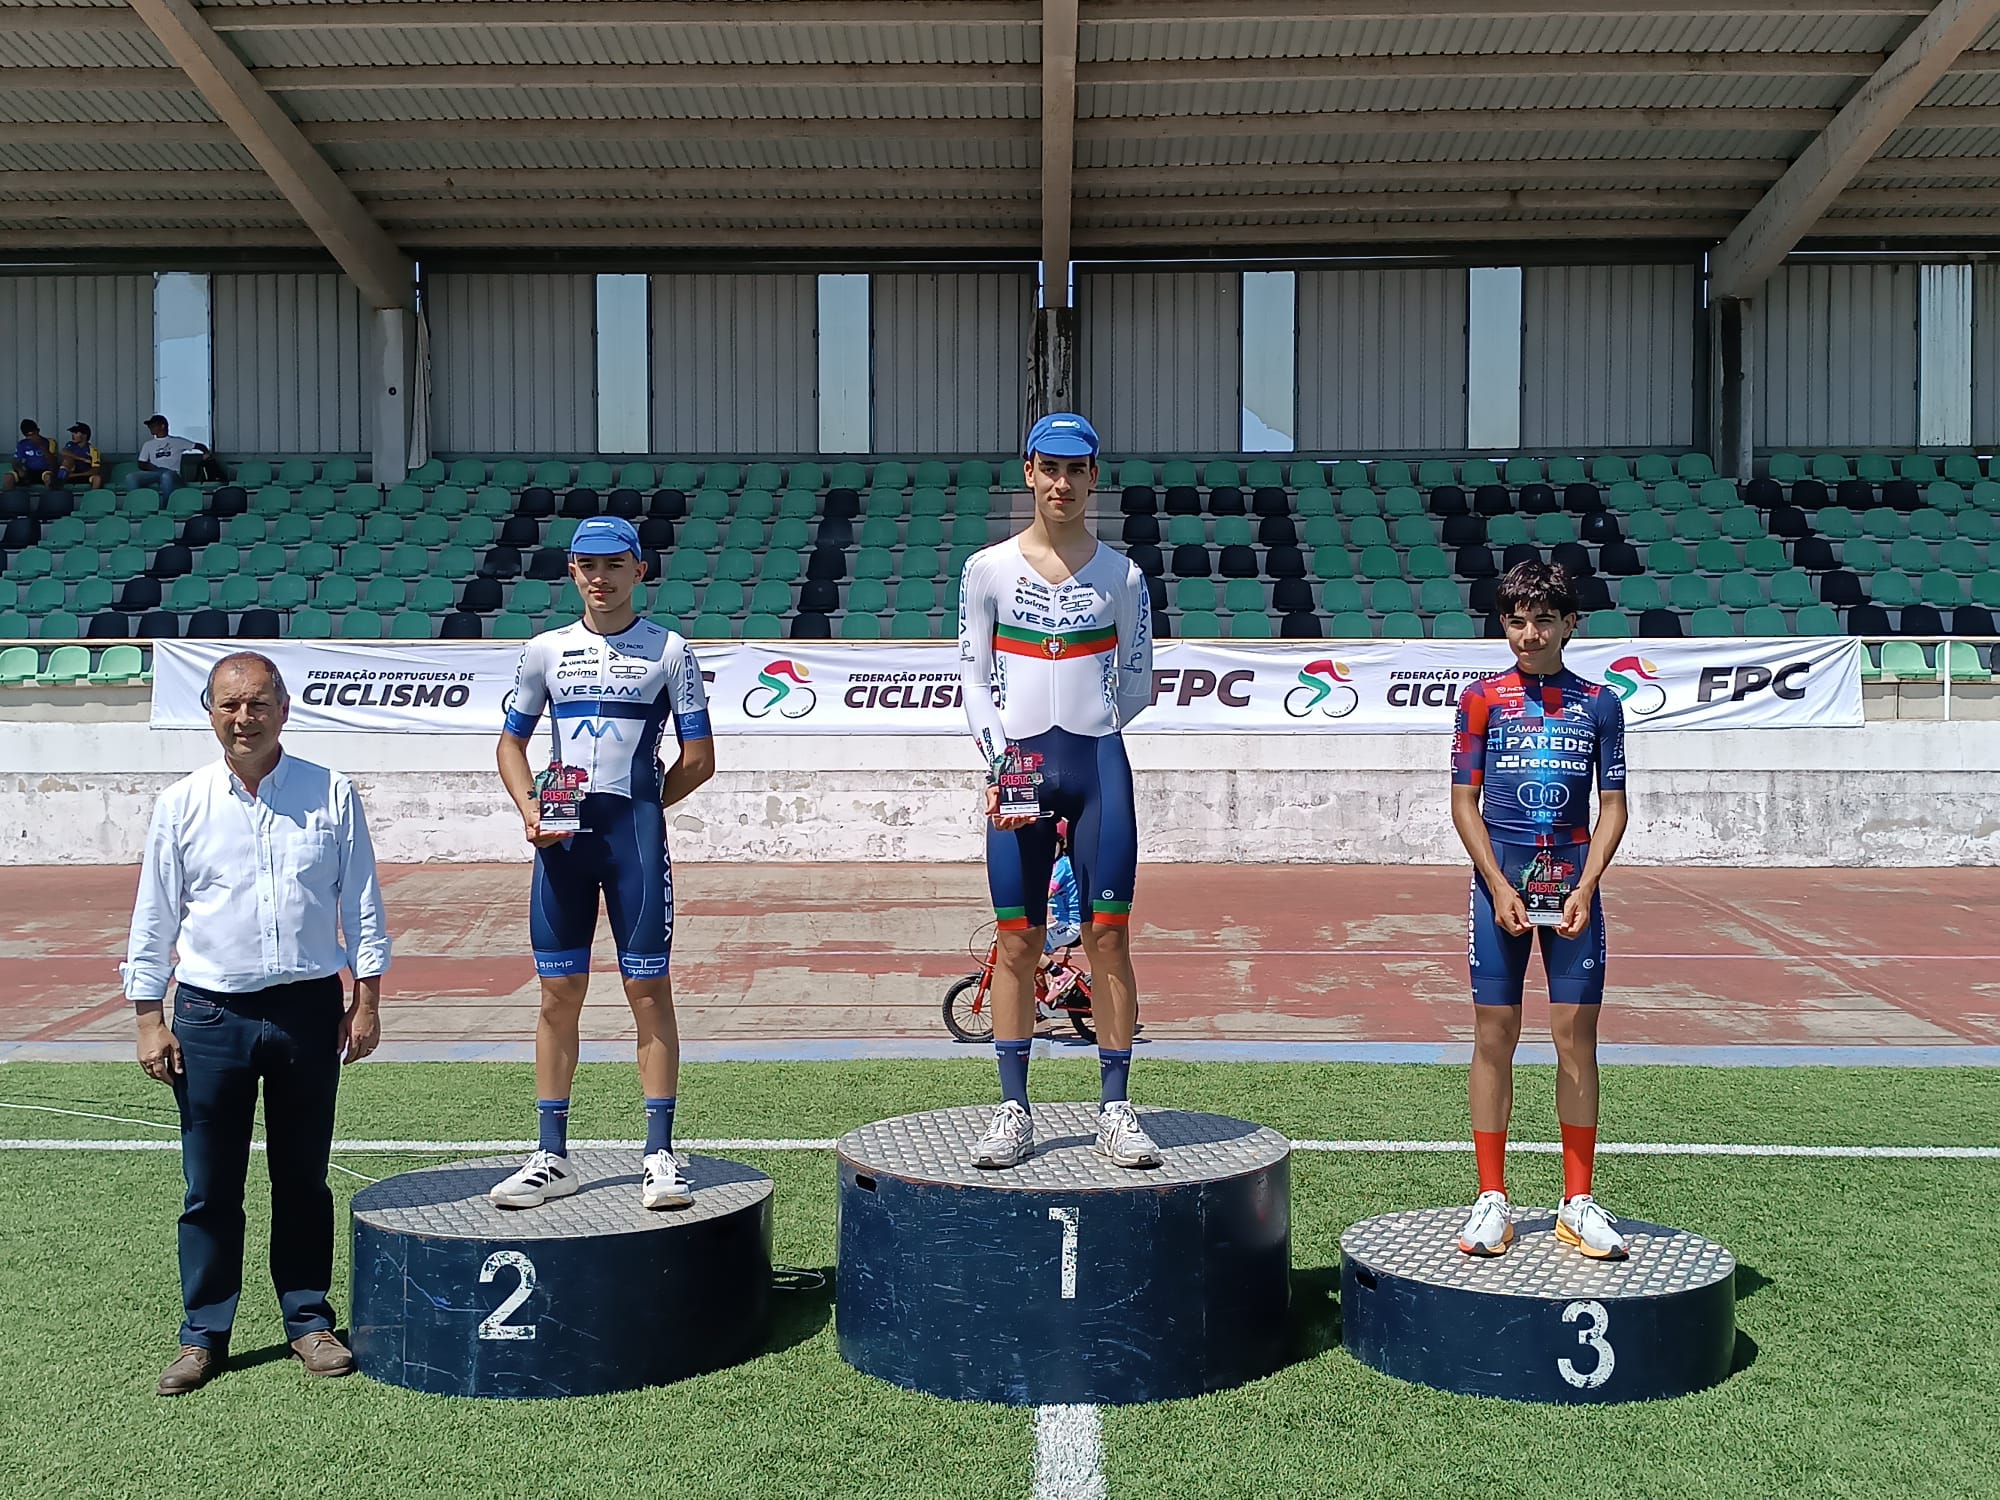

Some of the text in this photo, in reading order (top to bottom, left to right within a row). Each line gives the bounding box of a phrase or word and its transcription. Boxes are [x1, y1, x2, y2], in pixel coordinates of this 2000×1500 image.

[1012, 609, 1097, 628] VESAM
[307, 669, 475, 682] FEDERAÇÃO PORTUGUESA DE
[683, 643, 696, 712] VESAM
[848, 671, 917, 684] FEDERAÇÃO
[1390, 669, 1460, 682] FEDERAÇÃO
[1697, 662, 1811, 703] FPC
[302, 682, 470, 707] CICLISMO
[560, 684, 642, 697] VESAM
[844, 685, 1000, 709] CICLIS
[1150, 669, 1255, 708] FPC
[1386, 683, 1460, 707] CICL
[1506, 724, 1549, 734] CÂMARA
[1506, 736, 1594, 754] PAREDES
[1001, 774, 1033, 786] PISTA
[543, 789, 576, 801] PISTA
[663, 840, 673, 943] VESAM
[1528, 881, 1561, 893] PISTA
[1047, 1206, 1080, 1299] 1
[478, 1250, 538, 1340] 2
[1557, 1299, 1616, 1389] 3
